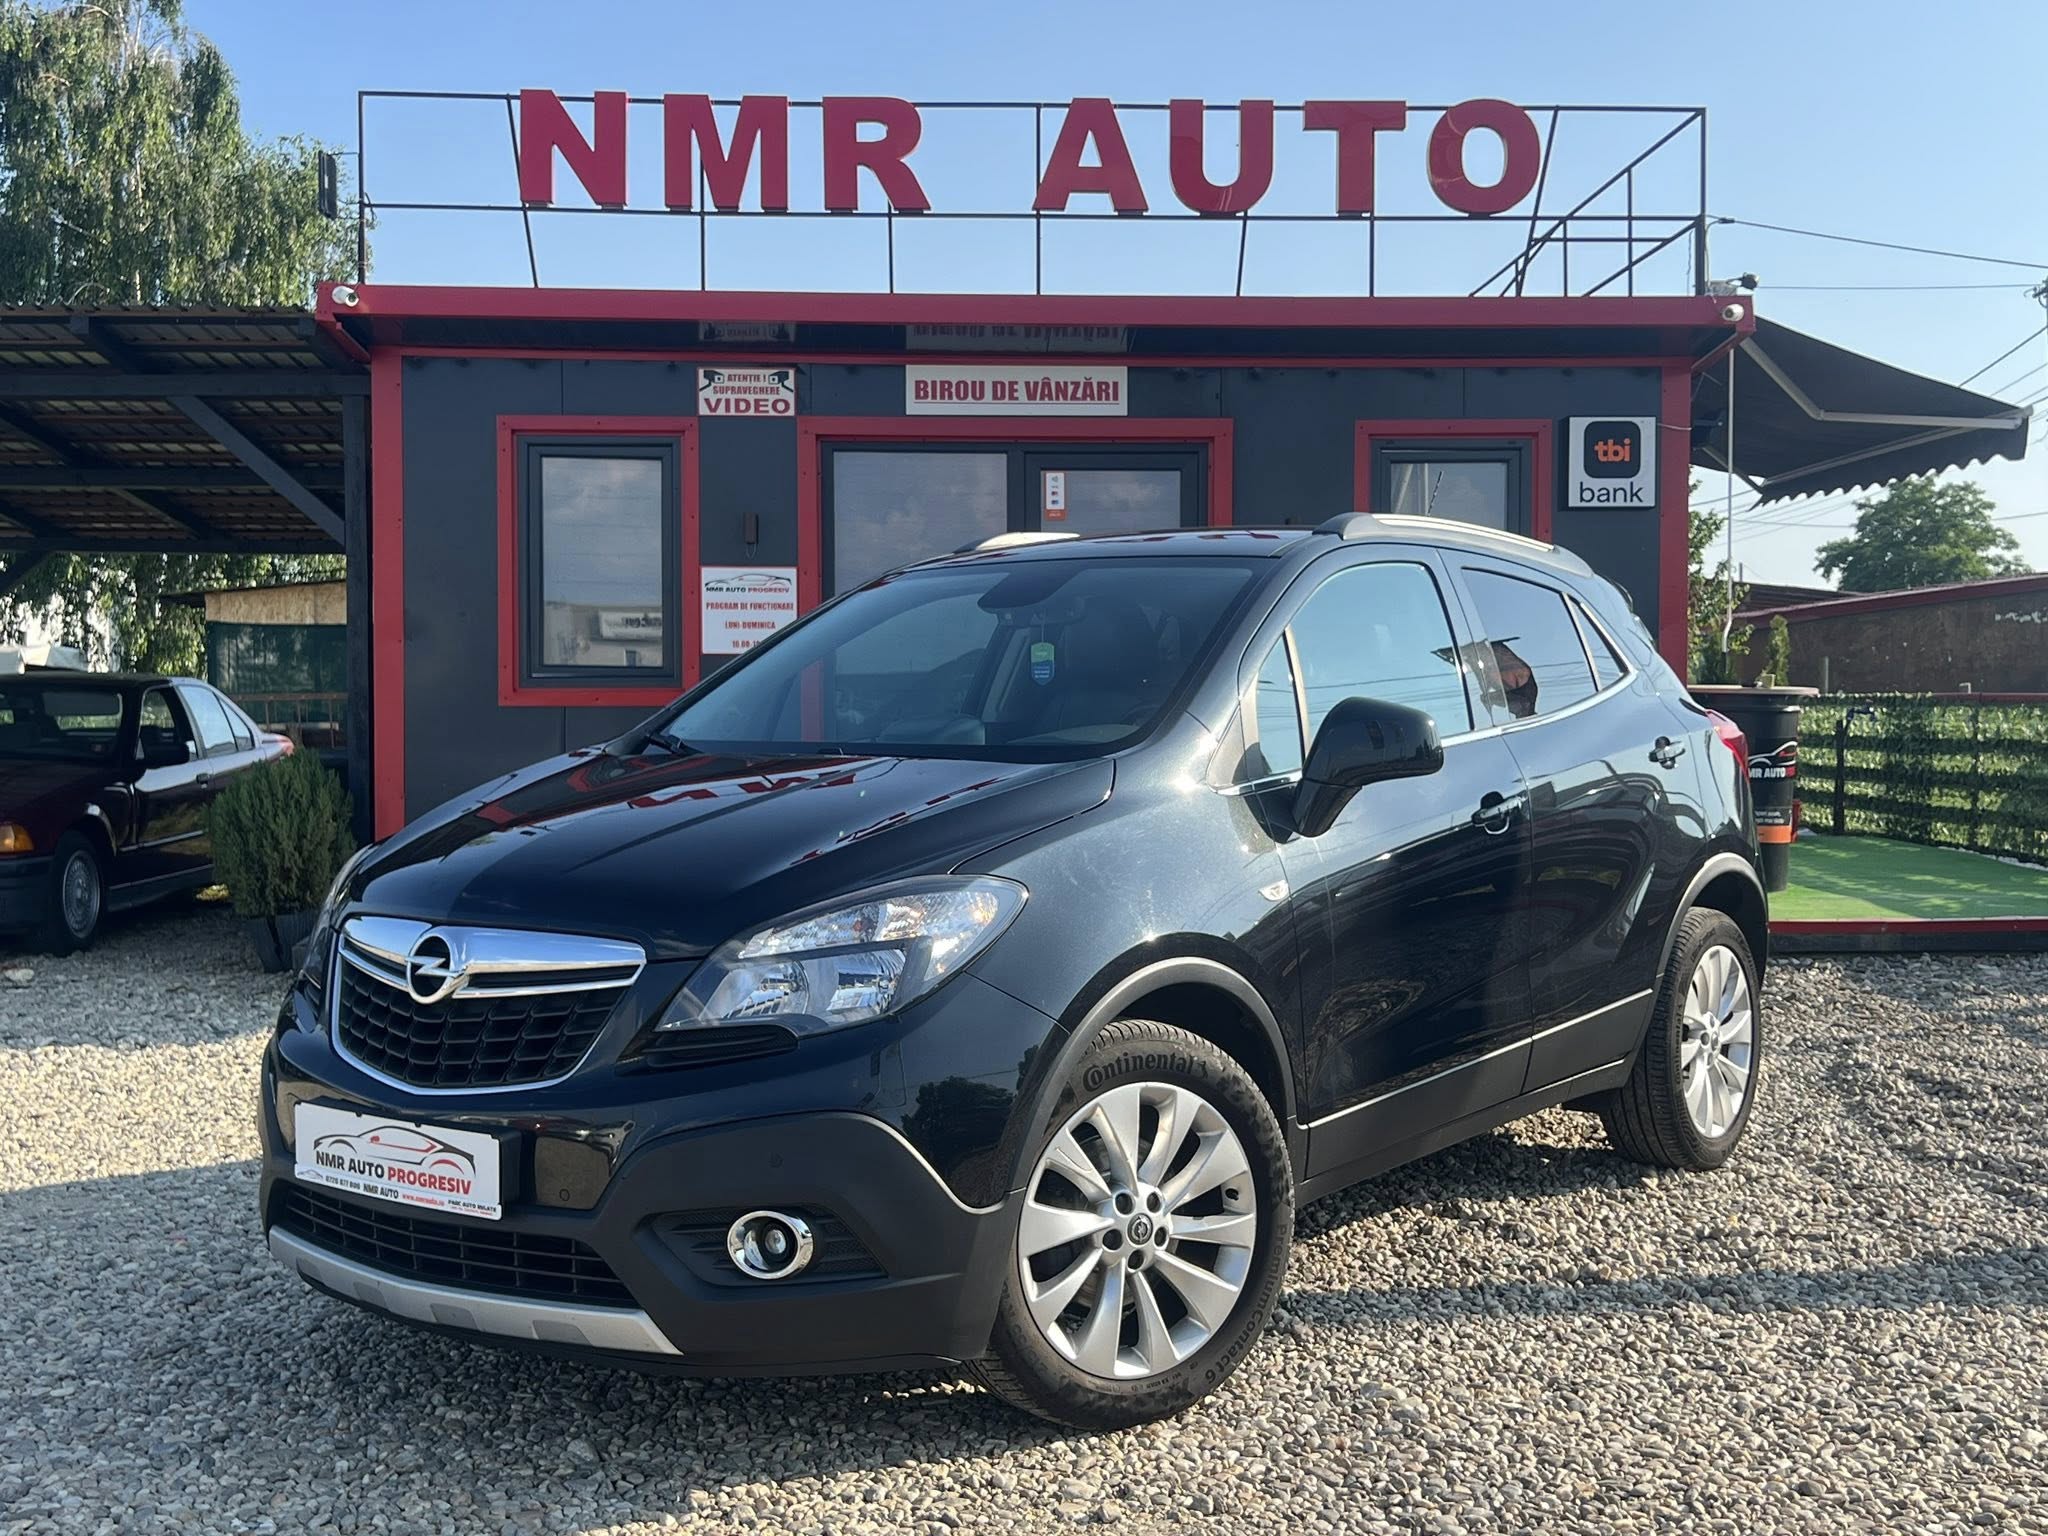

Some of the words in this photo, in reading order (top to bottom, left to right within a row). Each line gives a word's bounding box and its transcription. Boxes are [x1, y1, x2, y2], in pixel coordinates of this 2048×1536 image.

[520, 89, 931, 212] NMR
[1032, 97, 1541, 215] AUTO
[713, 386, 780, 395] SUPRAVEGHERE
[914, 379, 985, 401] BIROU
[992, 380, 1018, 401] DE
[1024, 376, 1120, 401] VÂNZĂRI
[704, 398, 790, 414] VIDEO
[1594, 438, 1631, 462] tbi
[1579, 481, 1644, 503] bank
[706, 602, 739, 610] PROGRAM
[740, 602, 748, 610] DE
[1763, 767, 1786, 778] AUTO
[1082, 1051, 1195, 1092] Continental
[316, 1151, 345, 1171] NMR
[348, 1159, 385, 1179] AUTO
[387, 1166, 472, 1195] PROGRESIV
[363, 1183, 378, 1195] NMR
[380, 1187, 399, 1199] AUTO
[1204, 1368, 1217, 1384] 6
